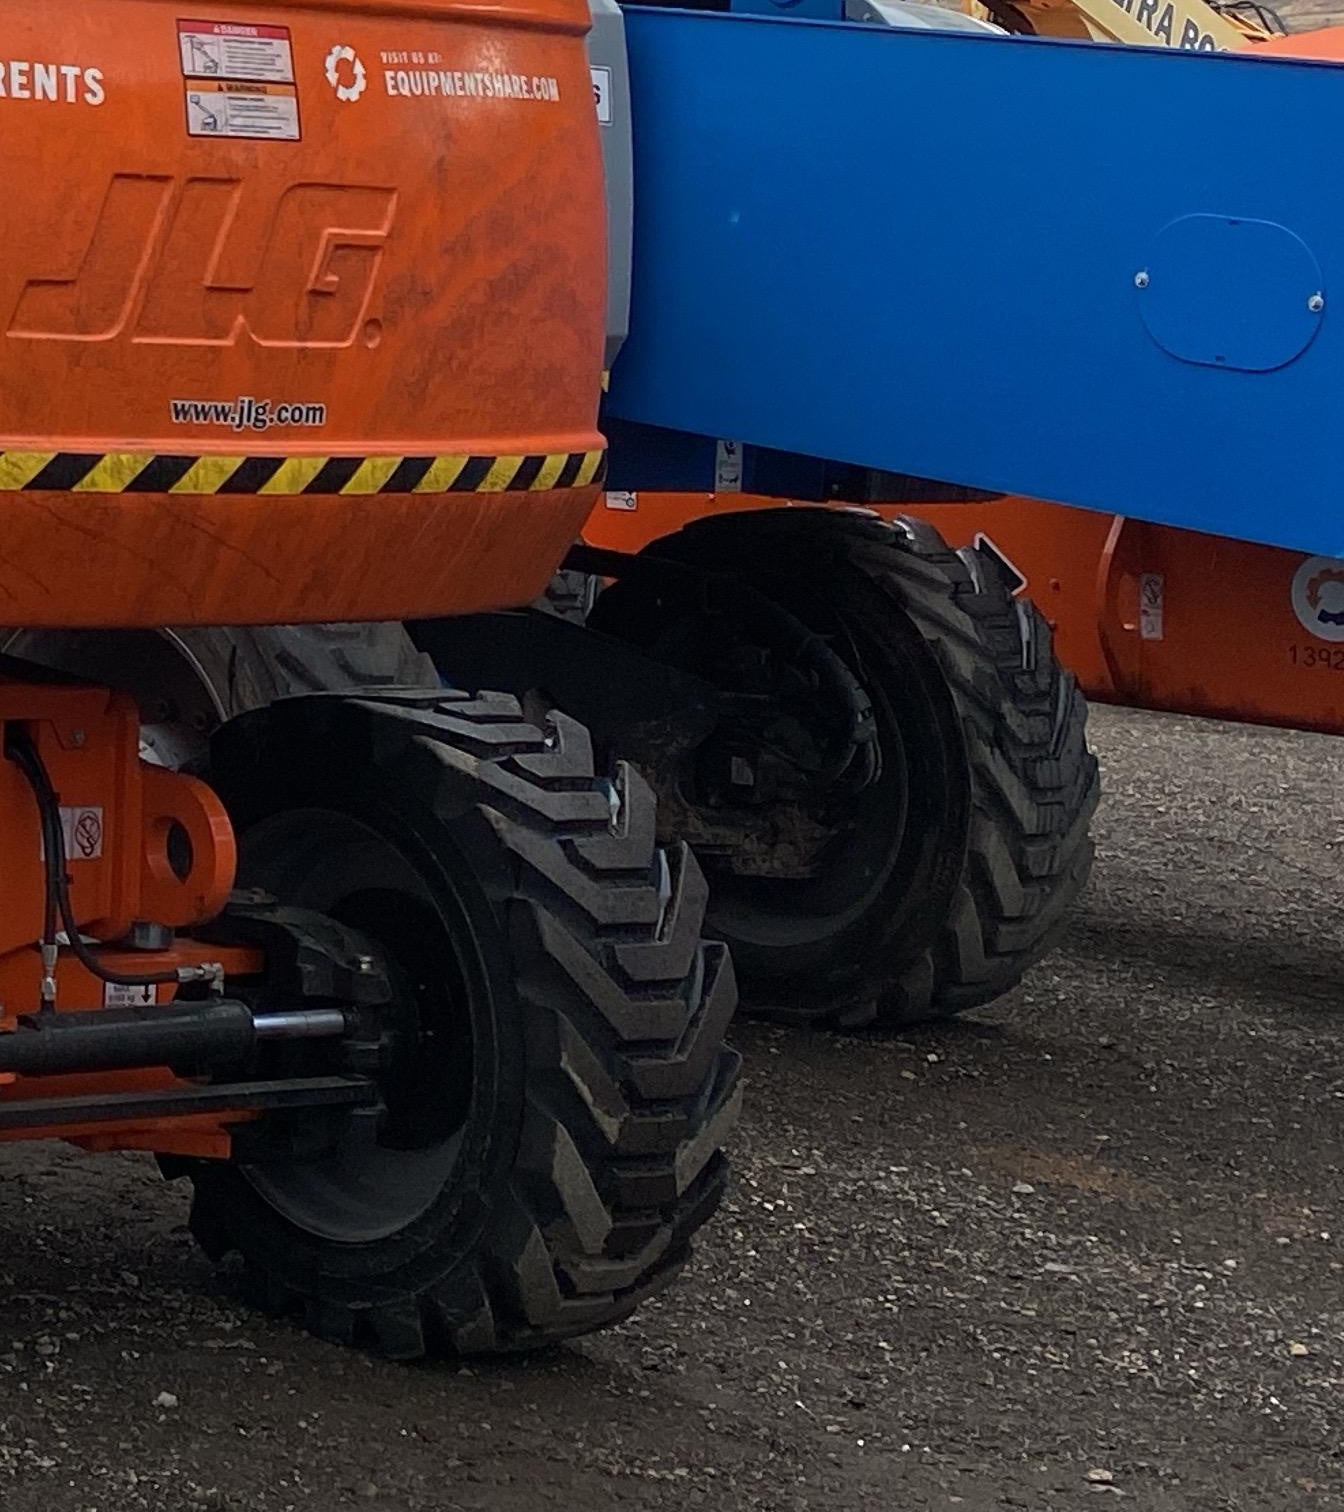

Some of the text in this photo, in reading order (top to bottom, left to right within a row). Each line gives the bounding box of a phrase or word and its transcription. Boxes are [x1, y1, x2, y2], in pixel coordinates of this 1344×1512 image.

[380, 51, 409, 64] VISIT
[412, 52, 425, 64] US
[384, 70, 560, 102] EQUIPMENTSHARE.COM
[6, 172, 399, 349] JLG
[171, 397, 326, 432] www.jlg.com
